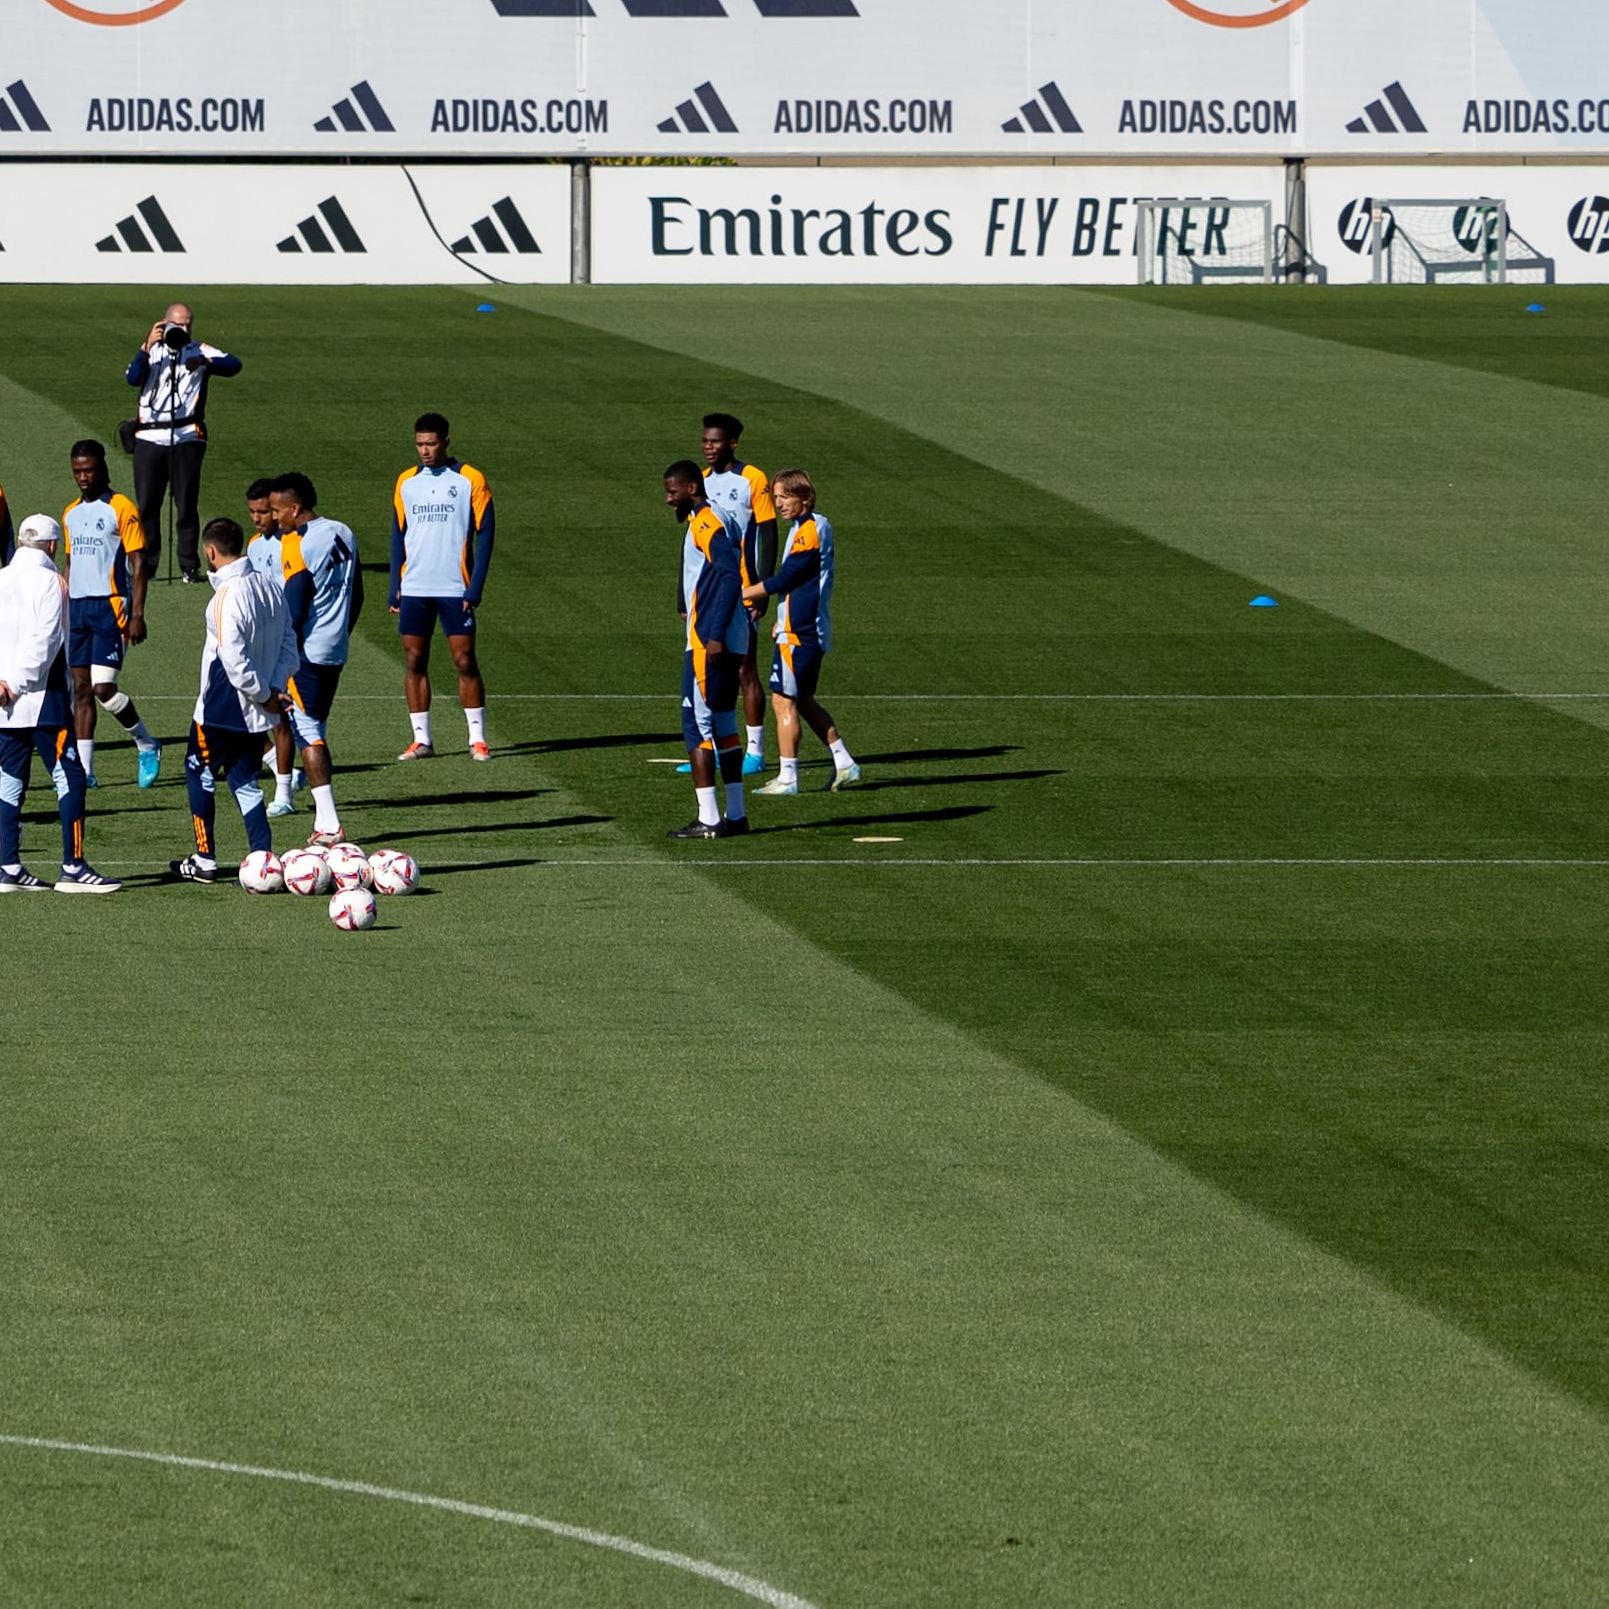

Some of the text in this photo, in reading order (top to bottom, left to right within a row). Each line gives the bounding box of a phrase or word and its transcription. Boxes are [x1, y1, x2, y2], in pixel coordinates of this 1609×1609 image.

[87, 98, 265, 133] ADIDAS.COM
[432, 99, 609, 134] ADIDAS.COM
[775, 100, 953, 135] ADIDAS.COM
[1119, 100, 1297, 135] ADIDAS.COM
[647, 195, 953, 257] Emirates
[985, 198, 1059, 257] FLY
[412, 502, 456, 514] Emirates
